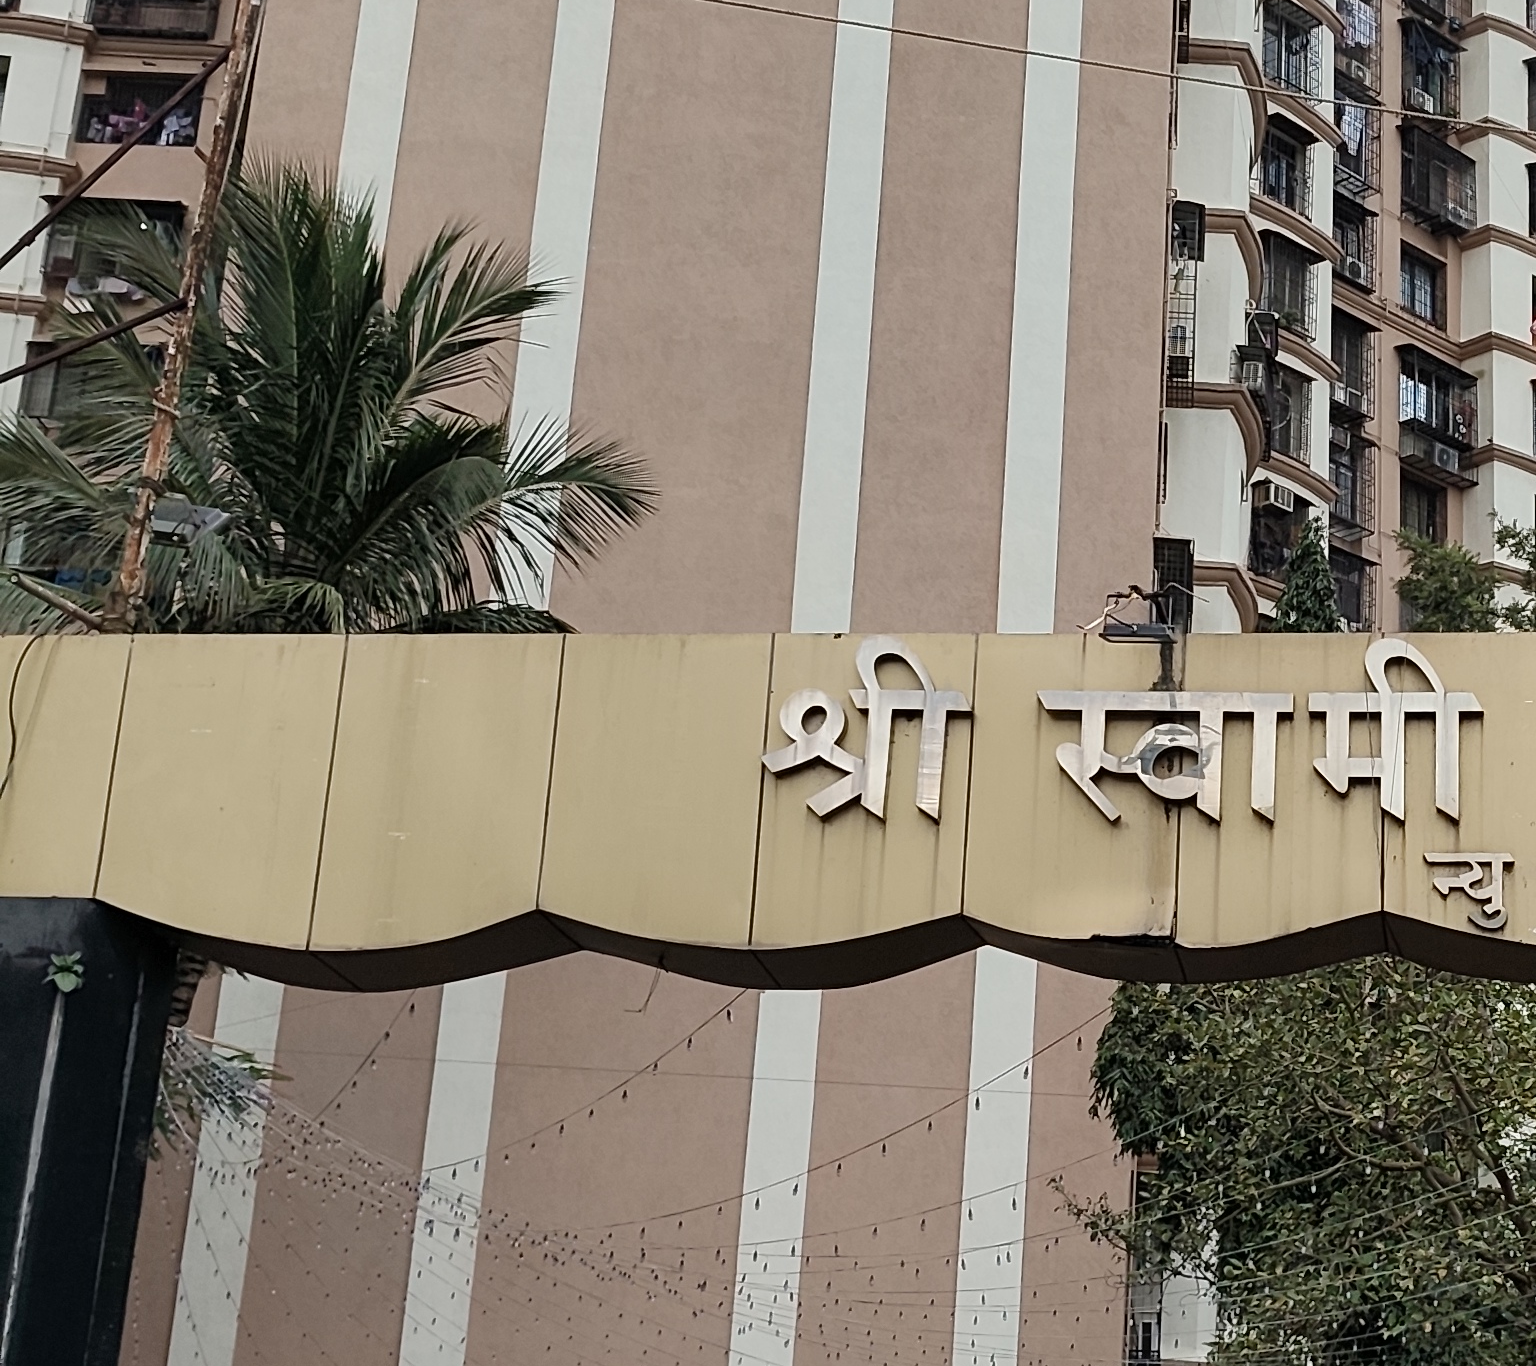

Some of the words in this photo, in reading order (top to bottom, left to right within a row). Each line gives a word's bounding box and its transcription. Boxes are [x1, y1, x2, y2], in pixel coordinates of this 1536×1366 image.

[761, 636, 974, 823] श्री
[1037, 638, 1484, 822] स्वामी
[1423, 852, 1515, 931] न्यु
